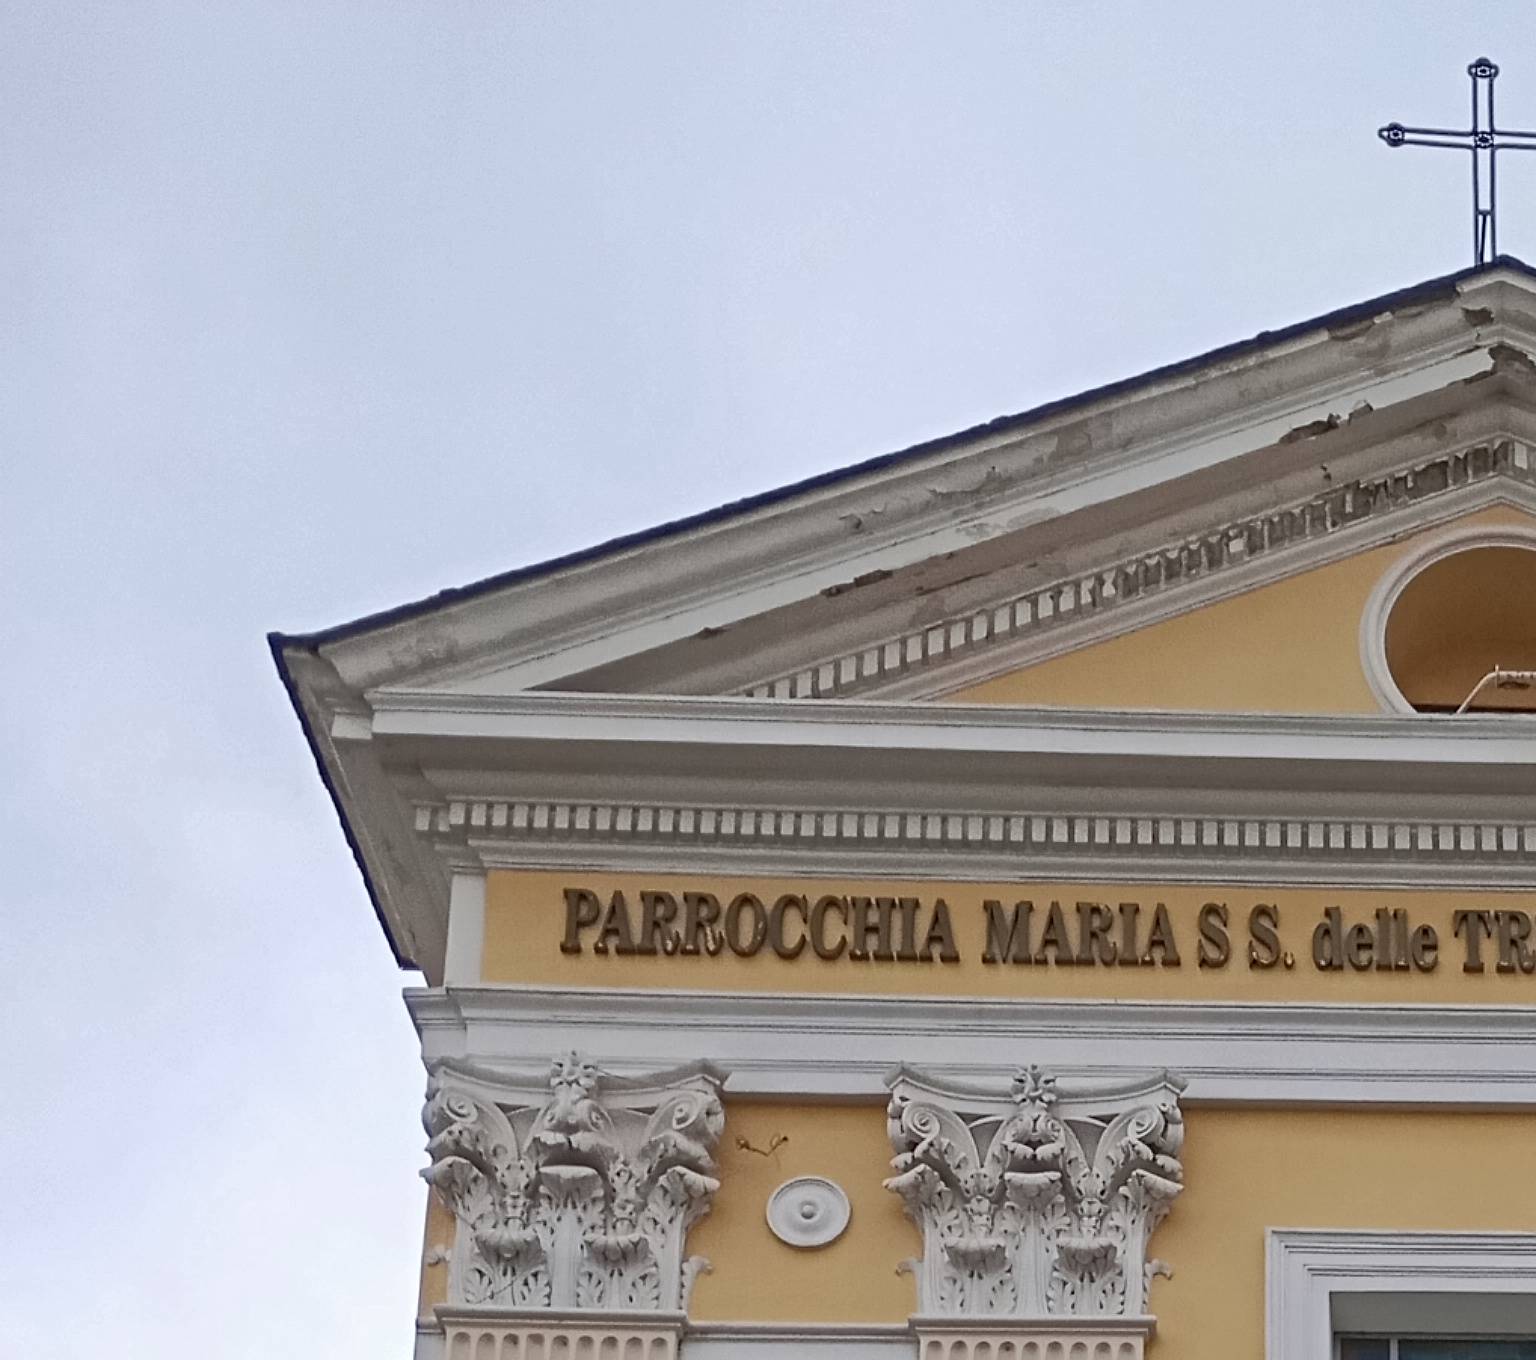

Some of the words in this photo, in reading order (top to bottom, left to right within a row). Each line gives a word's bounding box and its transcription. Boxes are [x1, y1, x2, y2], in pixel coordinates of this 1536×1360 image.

[560, 888, 960, 963] PARROCCHIA
[981, 899, 1181, 967] MARIA
[1312, 906, 1438, 972] delle
